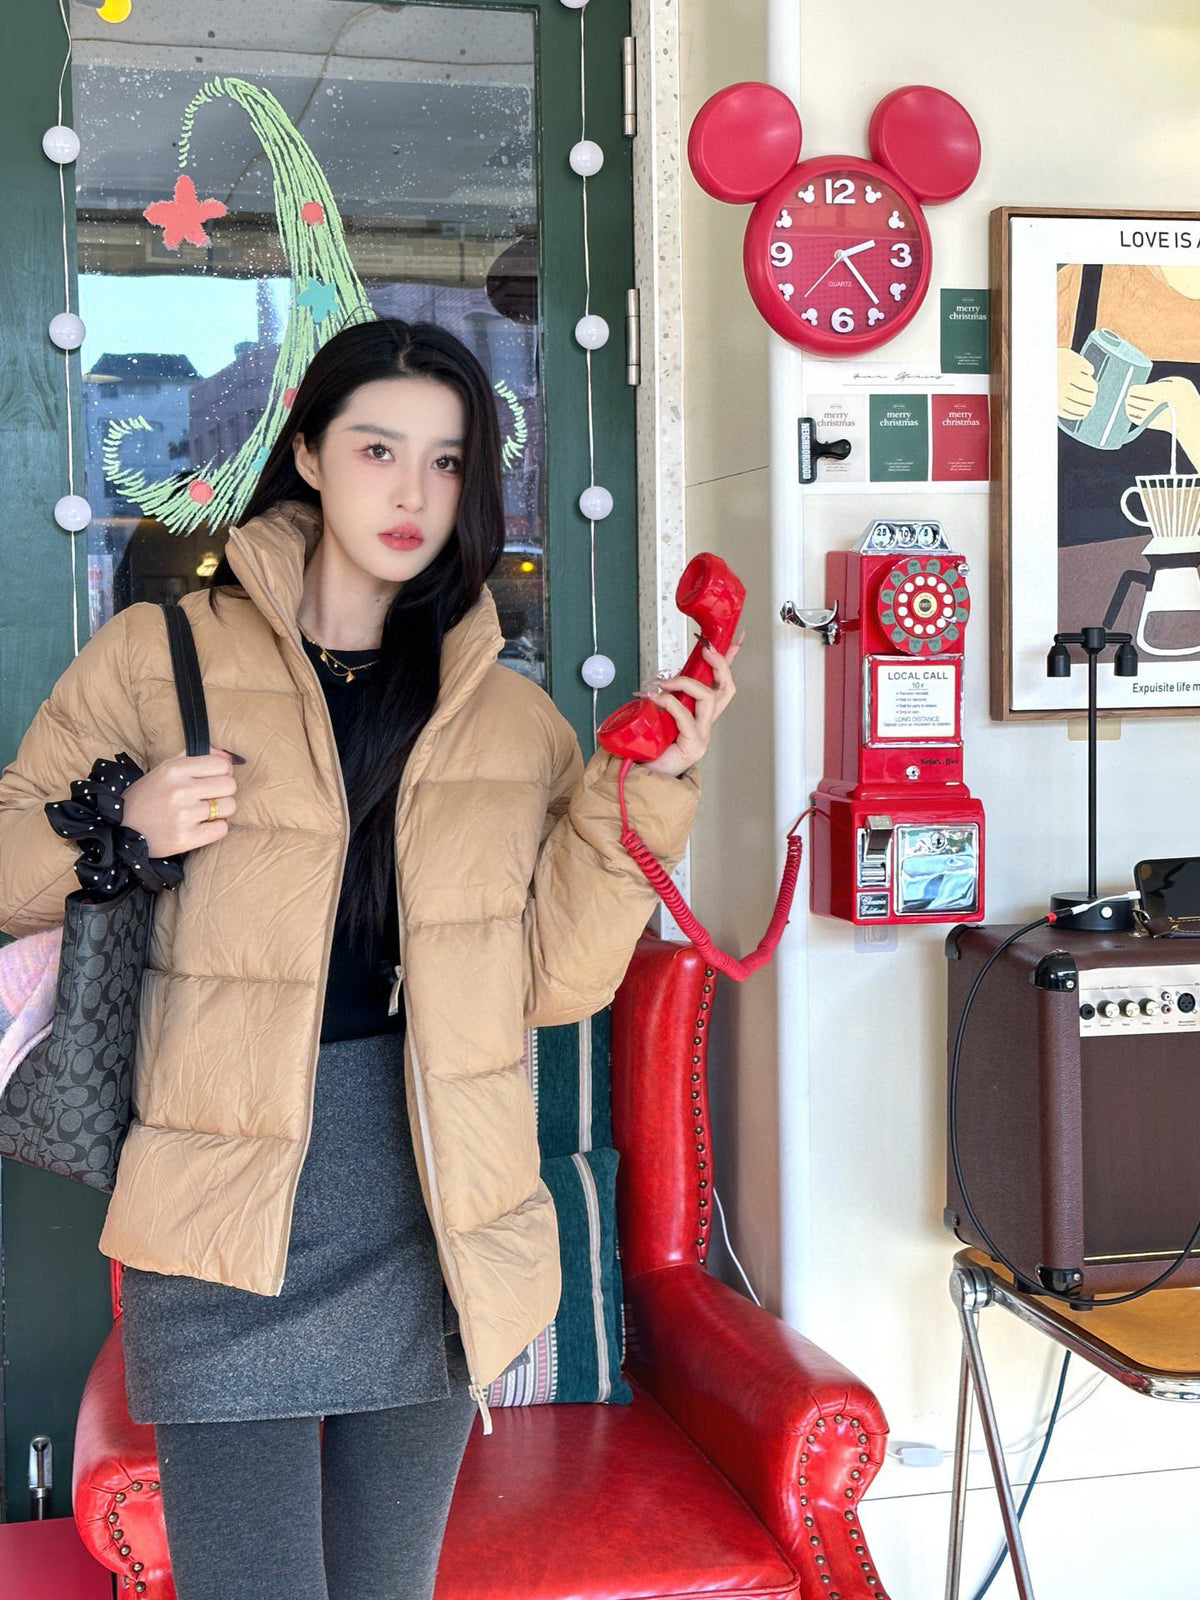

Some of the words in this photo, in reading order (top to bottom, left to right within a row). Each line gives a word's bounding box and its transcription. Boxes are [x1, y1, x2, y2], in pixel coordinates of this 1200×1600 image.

[825, 179, 856, 204] 12
[1120, 230, 1170, 248] LOVE
[1174, 231, 1192, 249] IS
[770, 241, 793, 267] 9
[889, 243, 912, 268] 3
[956, 305, 981, 314] merry
[831, 307, 854, 333] 6
[949, 312, 987, 320] christmas
[824, 412, 848, 422] merry
[886, 411, 911, 421] merry
[948, 411, 973, 421] merry
[817, 419, 855, 427] christmas
[879, 418, 918, 427] christmas
[942, 418, 980, 426] christmas
[877, 528, 887, 536] 25
[887, 671, 920, 680] LOCAL
[923, 671, 948, 680] CALL
[1176, 682, 1191, 692] life
